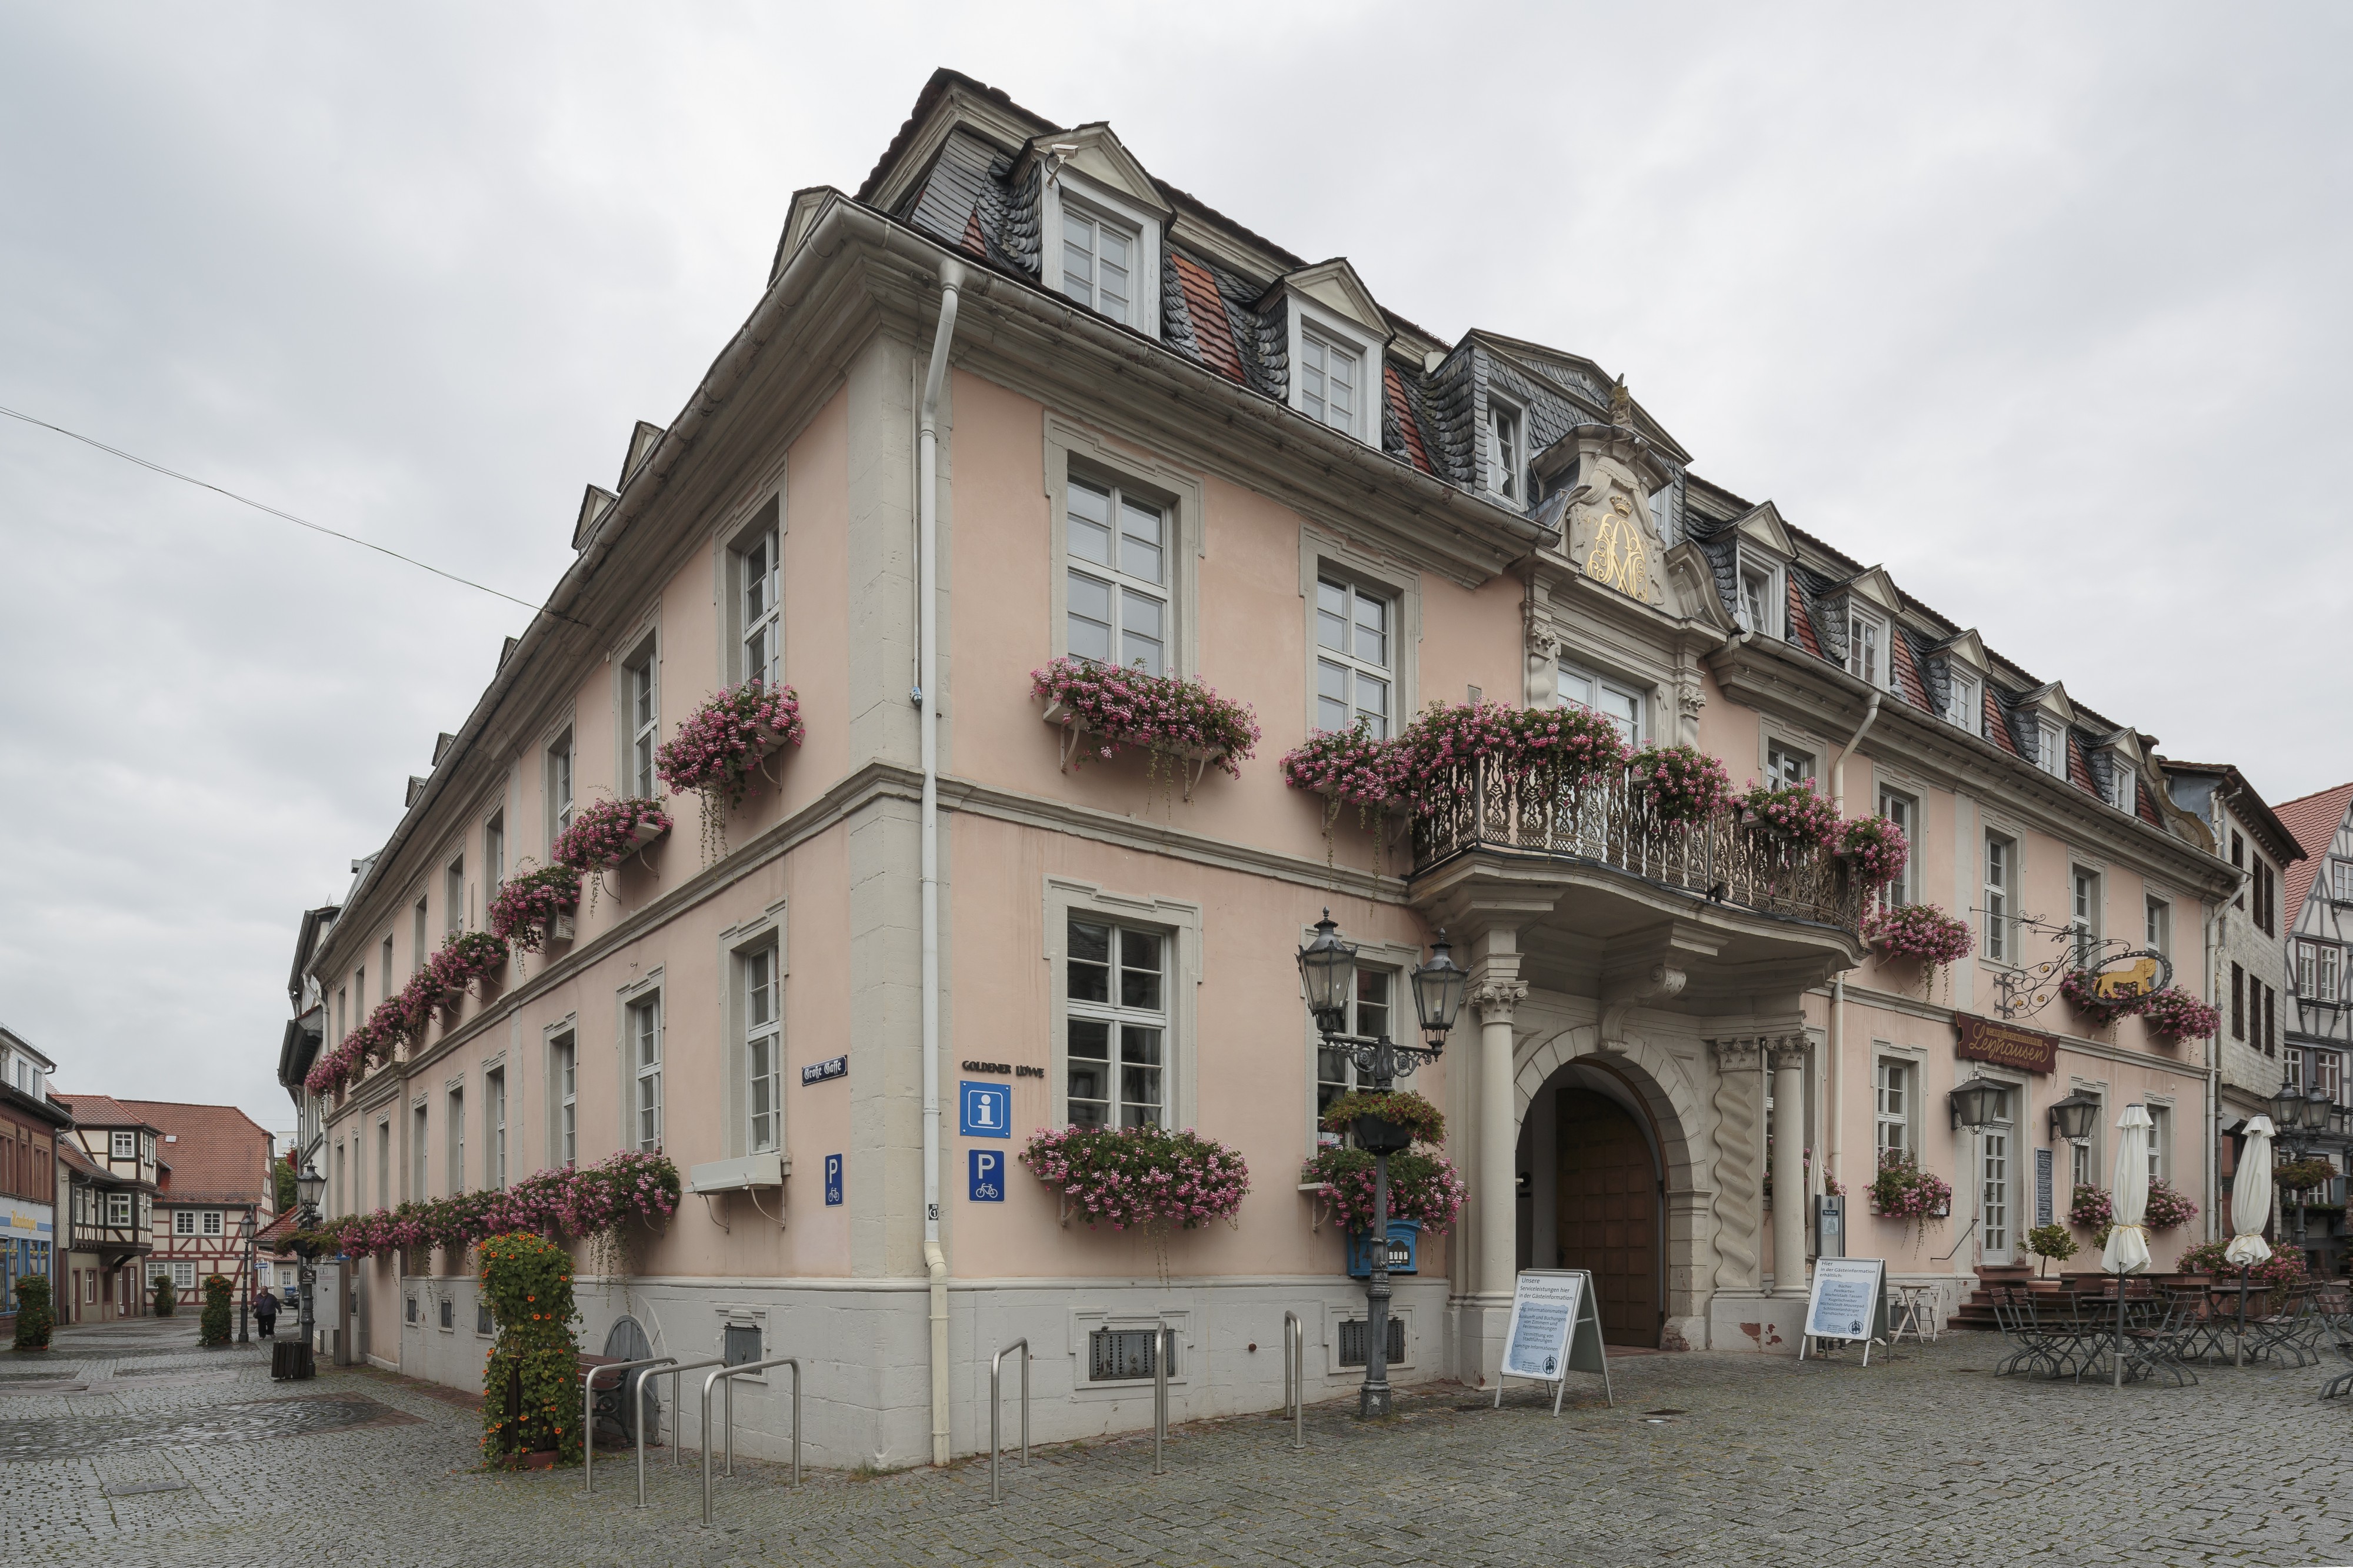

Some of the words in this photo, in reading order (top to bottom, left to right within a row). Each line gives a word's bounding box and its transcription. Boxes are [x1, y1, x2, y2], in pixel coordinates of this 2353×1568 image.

[962, 1060, 1012, 1075] GOLDENER
[1016, 1065, 1045, 1079] LÖWE
[2004, 1056, 2029, 1066] RATHAUS
[804, 1066, 822, 1080] Große
[829, 1159, 838, 1184] P
[978, 1154, 995, 1179] P
